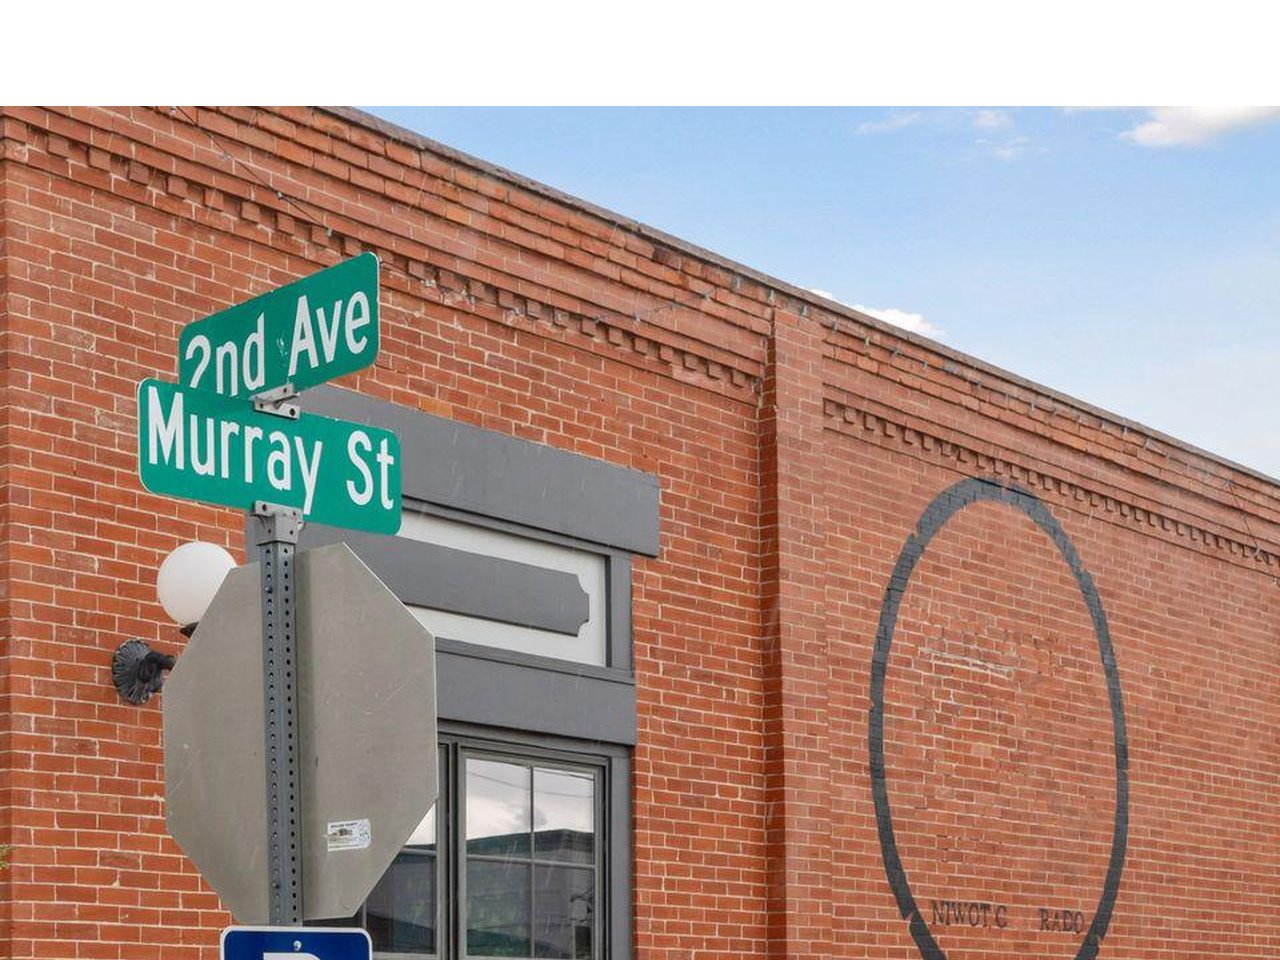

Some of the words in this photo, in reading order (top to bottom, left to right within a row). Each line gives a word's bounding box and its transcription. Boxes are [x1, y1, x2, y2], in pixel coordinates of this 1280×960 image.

[185, 311, 265, 397] 2nd
[288, 291, 370, 377] Ave
[148, 386, 322, 515] Murray
[346, 430, 394, 510] St
